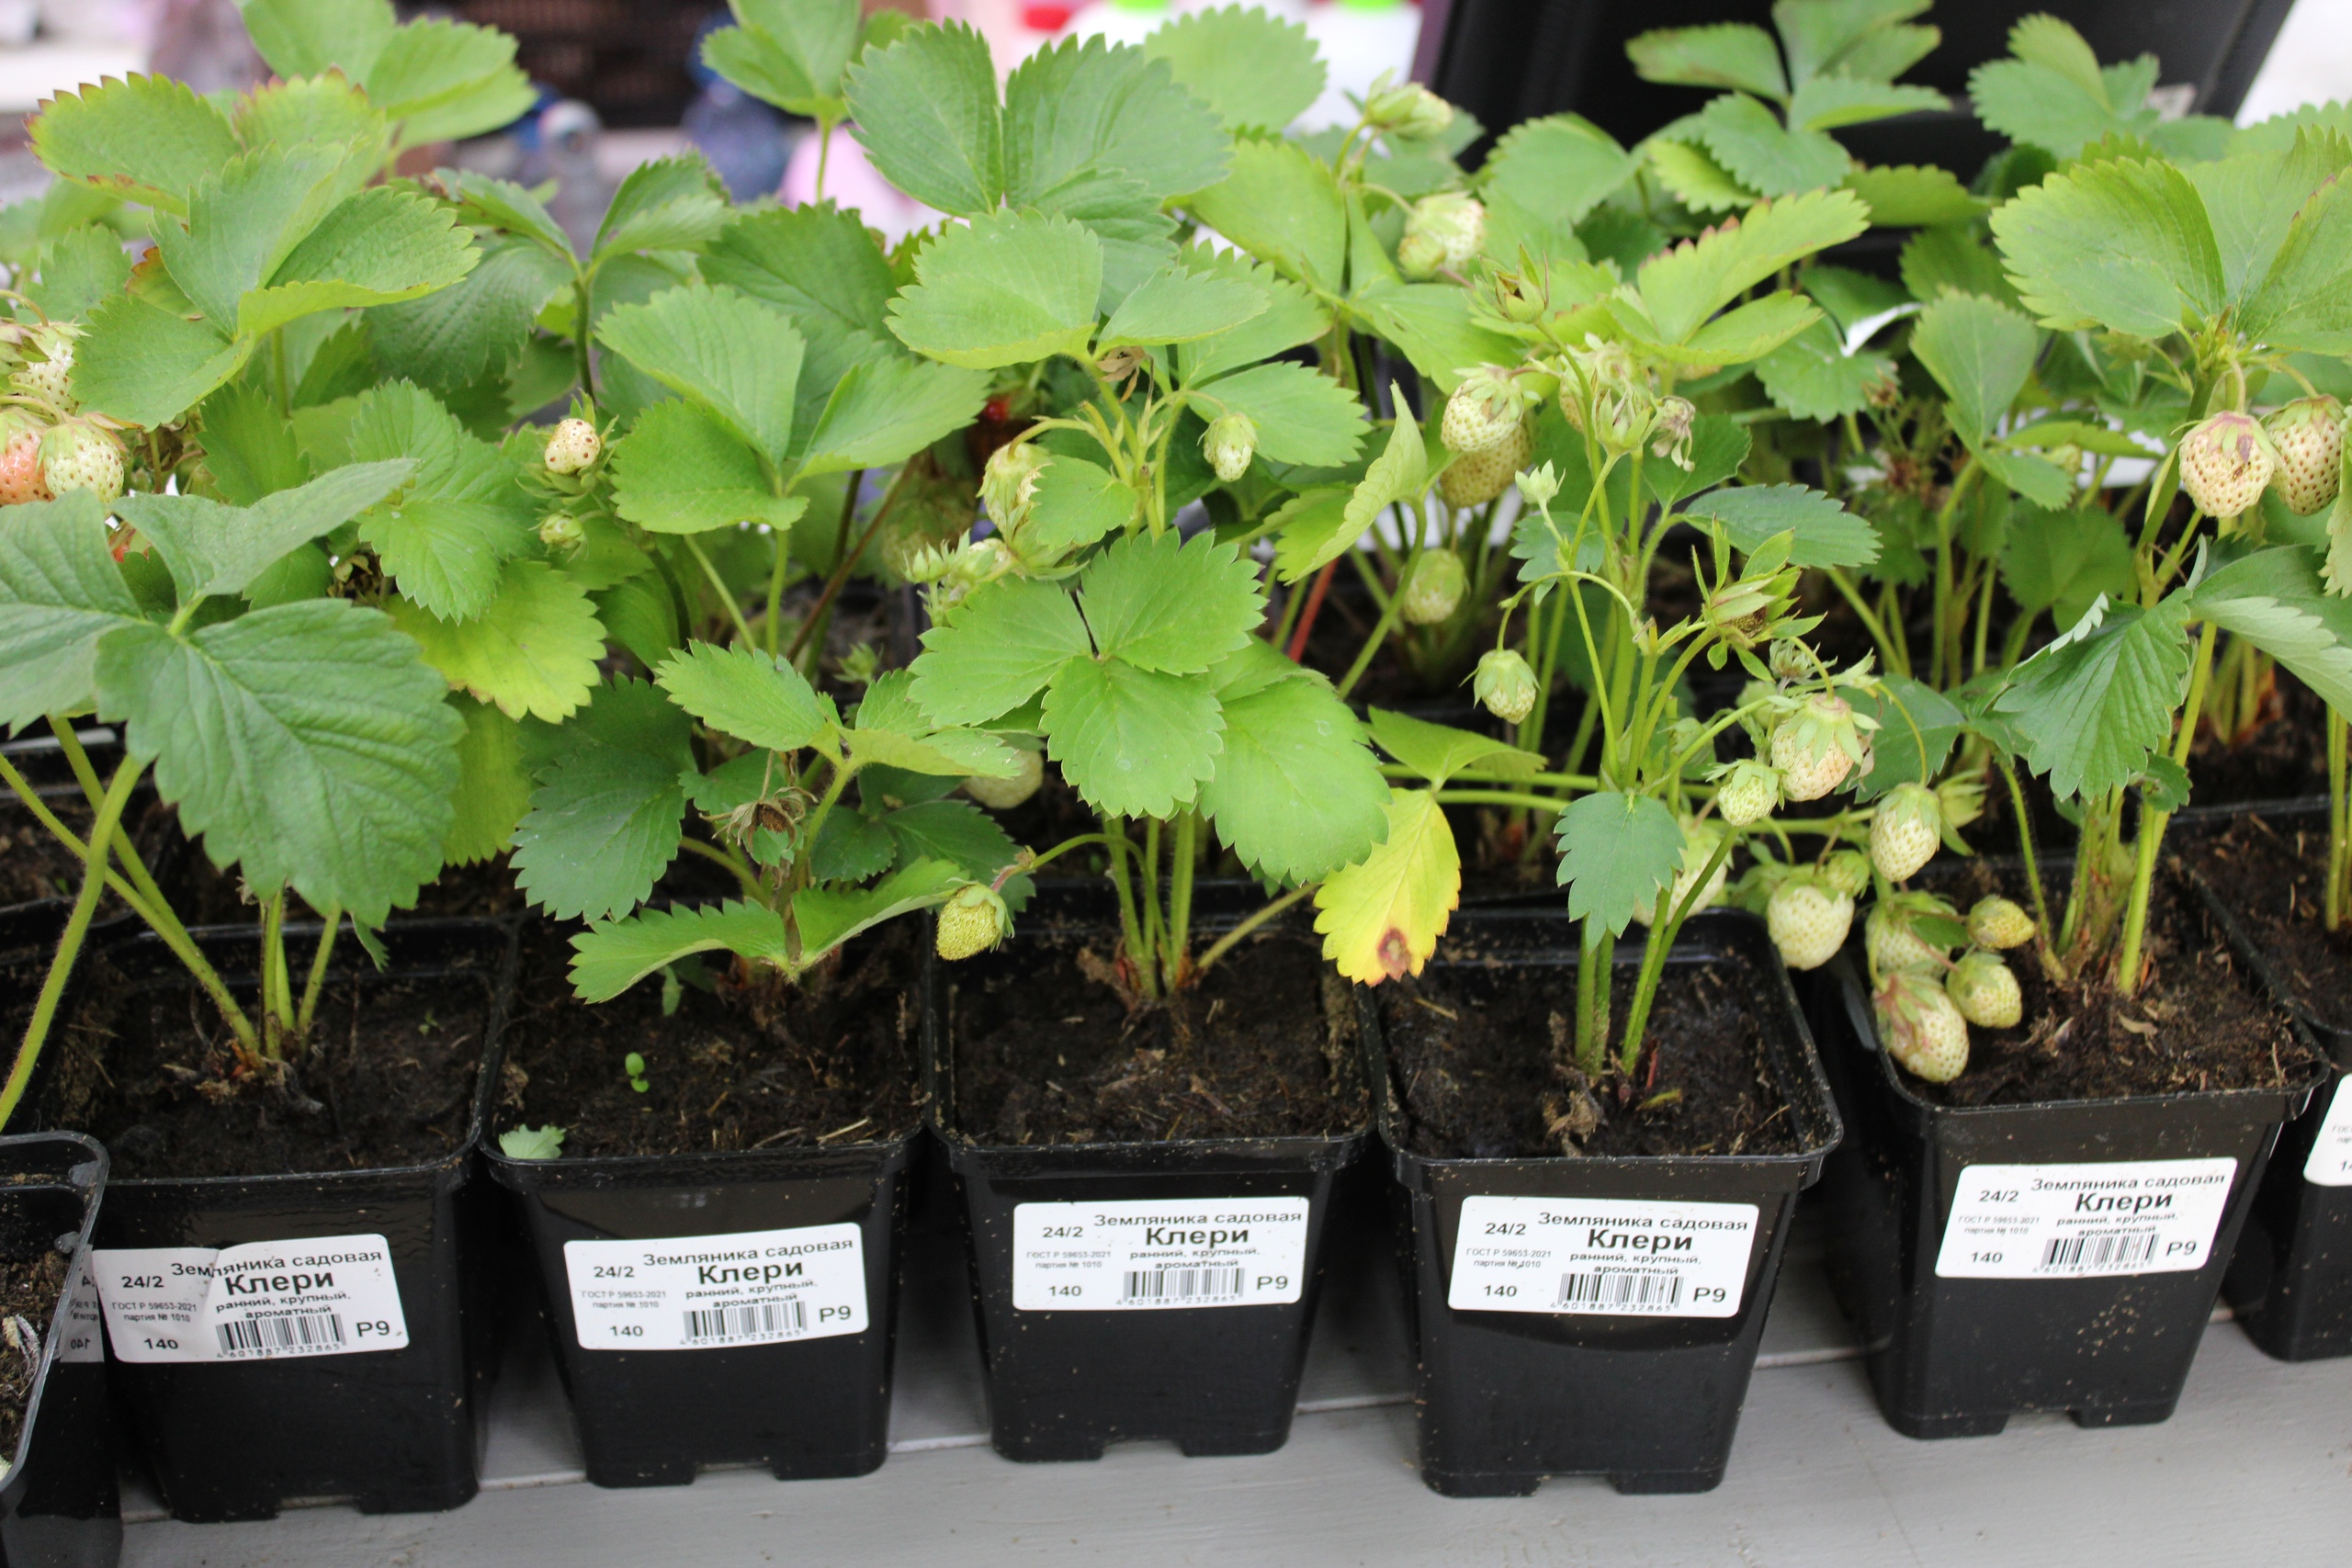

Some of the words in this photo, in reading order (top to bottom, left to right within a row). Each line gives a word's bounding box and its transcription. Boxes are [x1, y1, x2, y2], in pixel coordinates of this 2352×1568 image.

[2030, 1179, 2138, 1191] Земляника
[2144, 1174, 2225, 1189] садовая
[1979, 1190, 2019, 1202] 24/2
[2075, 1193, 2173, 1214] Клери
[1094, 1213, 1207, 1226] Земляника
[1215, 1213, 1302, 1224] садовая
[1538, 1213, 1653, 1228] Земляника
[1660, 1217, 1747, 1231] садовая
[2056, 1216, 2110, 1227] ранний,
[1043, 1227, 1083, 1238] 24/2
[1485, 1223, 1526, 1235] 24/2
[2077, 1225, 2156, 1238] ароматный
[1147, 1227, 1249, 1248] Клери
[1588, 1229, 1692, 1254] Клери
[643, 1248, 759, 1266] Земляника
[765, 1240, 853, 1258] садовая
[1130, 1250, 1187, 1260] ранний,
[1466, 1248, 1491, 1257] ГОСТ
[1570, 1253, 1627, 1263] ранний,
[1971, 1252, 2002, 1263] 140
[171, 1258, 286, 1278] Земляника
[292, 1250, 382, 1268] садовая
[1035, 1261, 1067, 1269] партия
[1155, 1259, 1238, 1271] ароматный
[1474, 1259, 1505, 1269] партия
[594, 1266, 635, 1278] 24/2
[698, 1262, 803, 1284] Клери
[1594, 1266, 1679, 1276] ароматный
[121, 1276, 164, 1288] 24/2
[225, 1272, 334, 1296] Клери
[686, 1286, 744, 1300] ранний,
[1048, 1286, 1081, 1297] 140
[1484, 1285, 1517, 1297] 140
[216, 1297, 276, 1313] ранний,
[593, 1301, 623, 1310] партия
[713, 1293, 797, 1308] ароматный
[112, 1303, 137, 1311] ГОСТ
[246, 1305, 332, 1321] ароматный
[124, 1313, 155, 1323] партия
[610, 1325, 643, 1337] 140
[144, 1338, 178, 1349] 140
